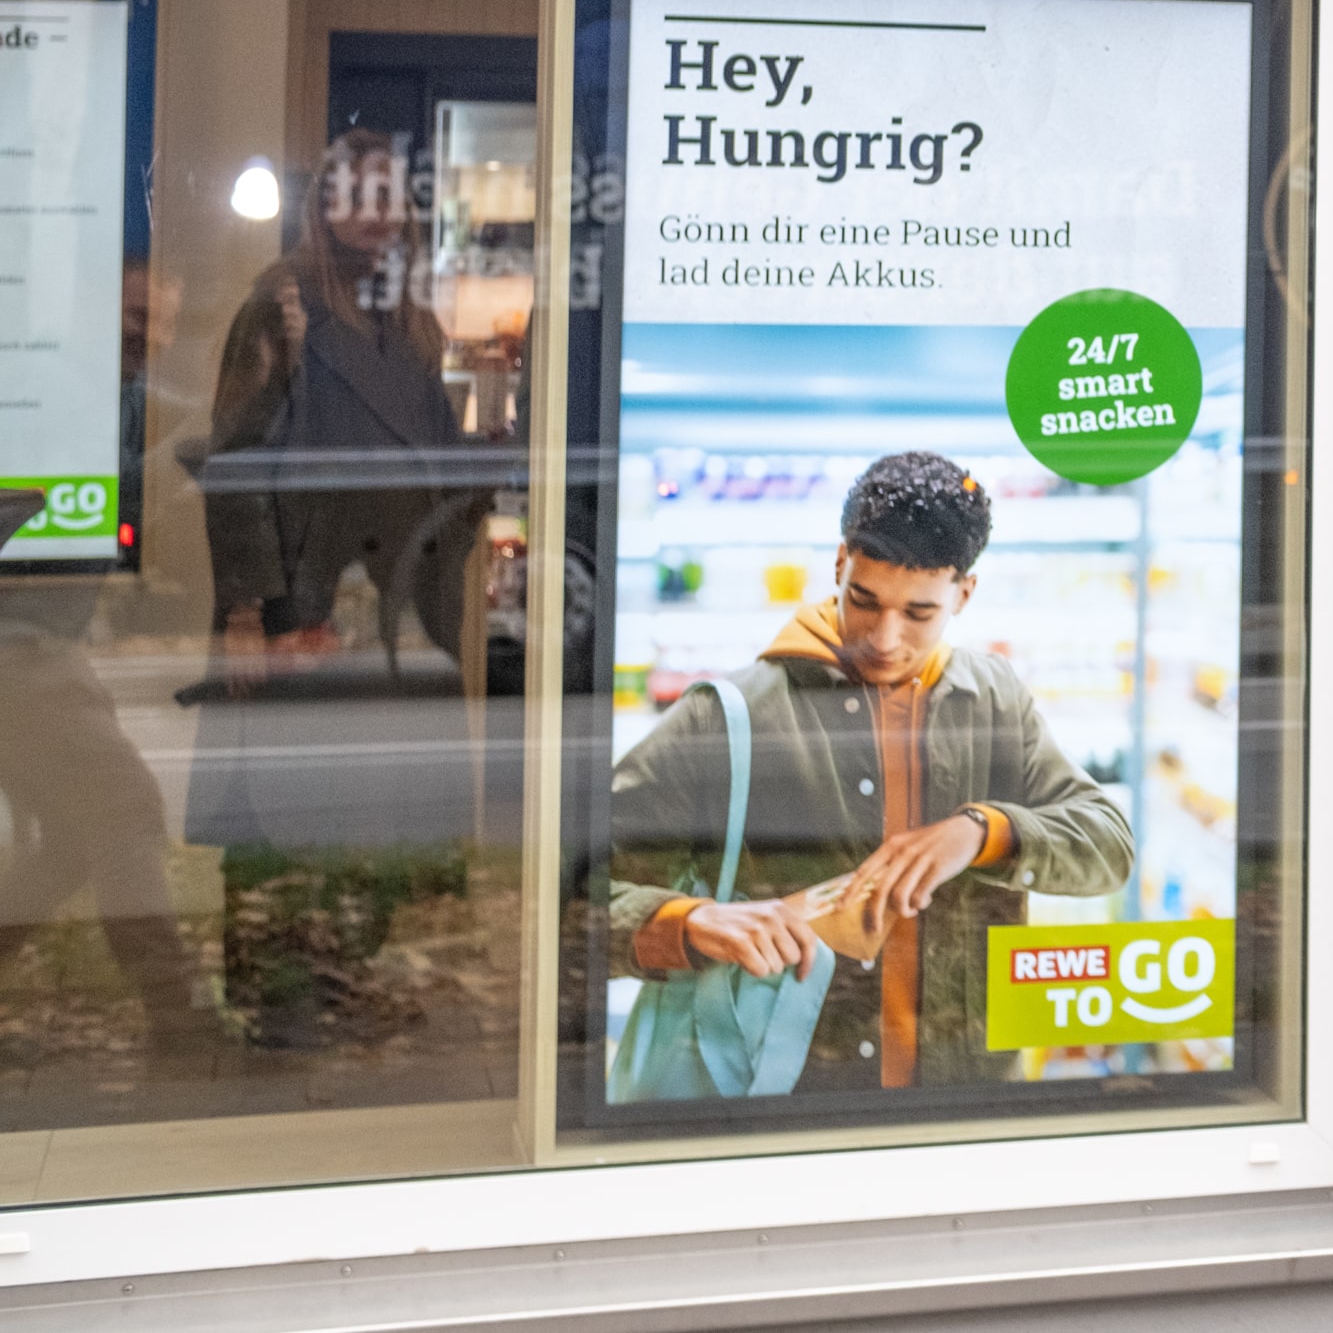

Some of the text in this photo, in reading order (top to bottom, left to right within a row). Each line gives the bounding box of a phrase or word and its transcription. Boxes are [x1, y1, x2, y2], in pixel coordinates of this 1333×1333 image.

[664, 38, 815, 107] Hey,
[660, 114, 985, 185] Hungrig?
[658, 213, 1072, 248] Gönn dir eine Pause und
[658, 256, 944, 289] lad deine Akkus.
[1066, 332, 1140, 366] 24/7
[1058, 367, 1154, 401] smart
[1040, 399, 1177, 437] snacken
[50, 482, 107, 514] GO
[1014, 948, 1107, 981] REWE
[1045, 936, 1216, 1028] TO GO
